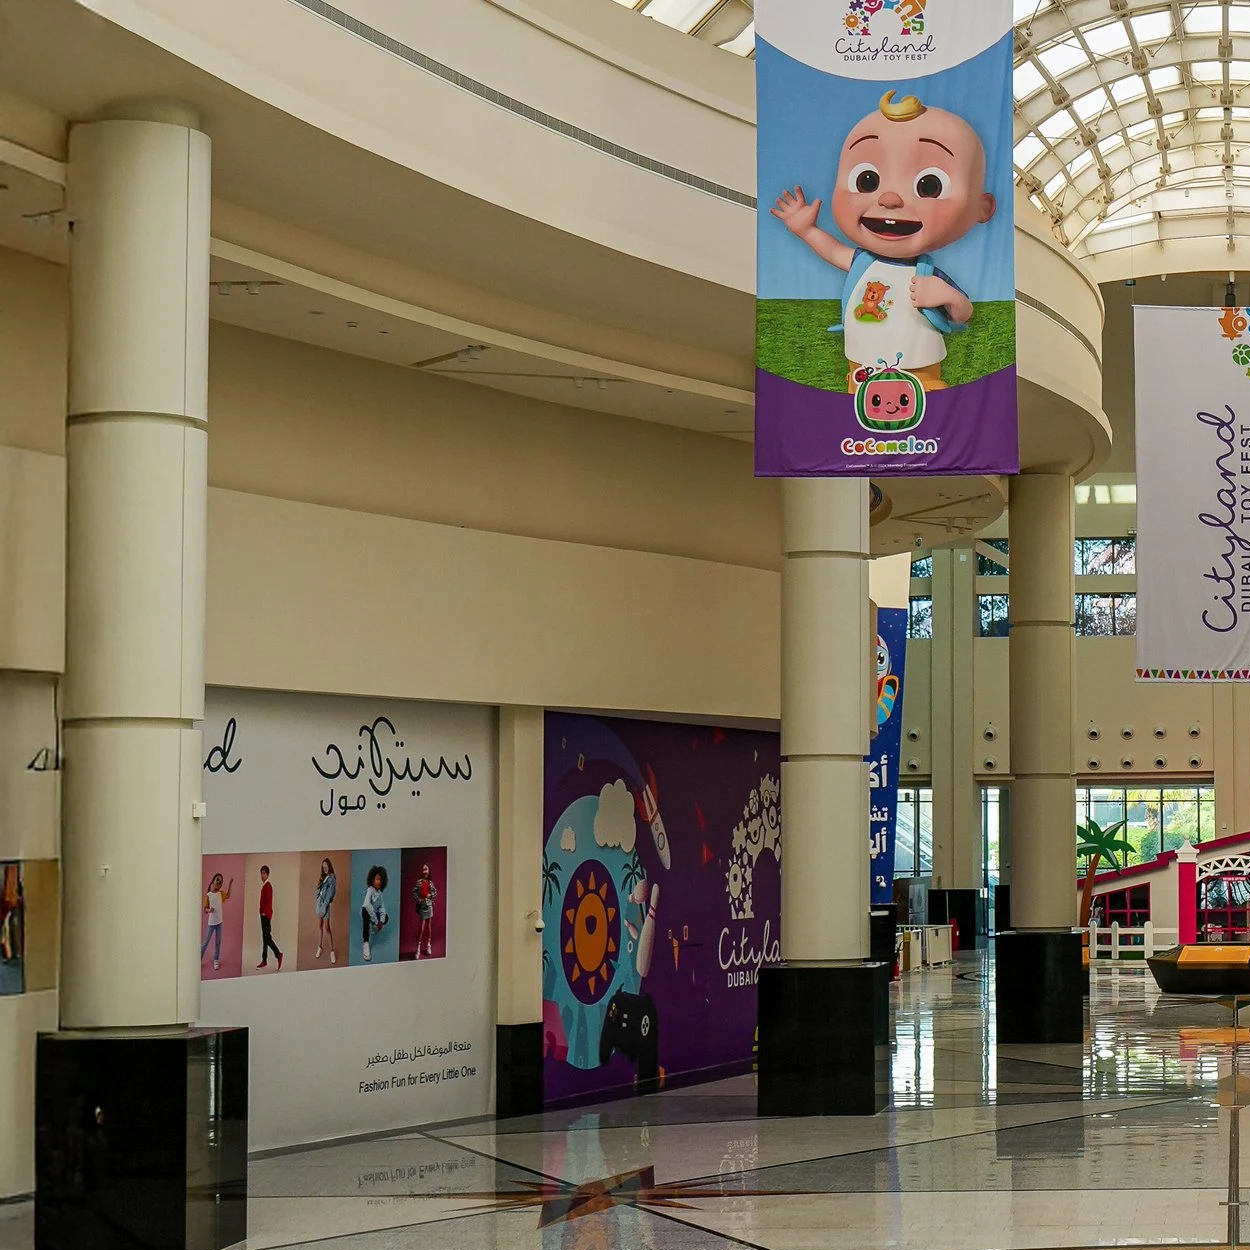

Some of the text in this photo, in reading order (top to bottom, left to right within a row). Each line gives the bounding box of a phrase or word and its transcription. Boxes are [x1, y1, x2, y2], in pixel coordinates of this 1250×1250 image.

[835, 35, 936, 61] Cityland
[905, 53, 928, 61] FEST
[320, 788, 367, 816] مول
[718, 919, 782, 985] Cityla
[727, 970, 754, 988] DUBAI
[358, 1065, 477, 1094] Fashion Fun for Every Little One
